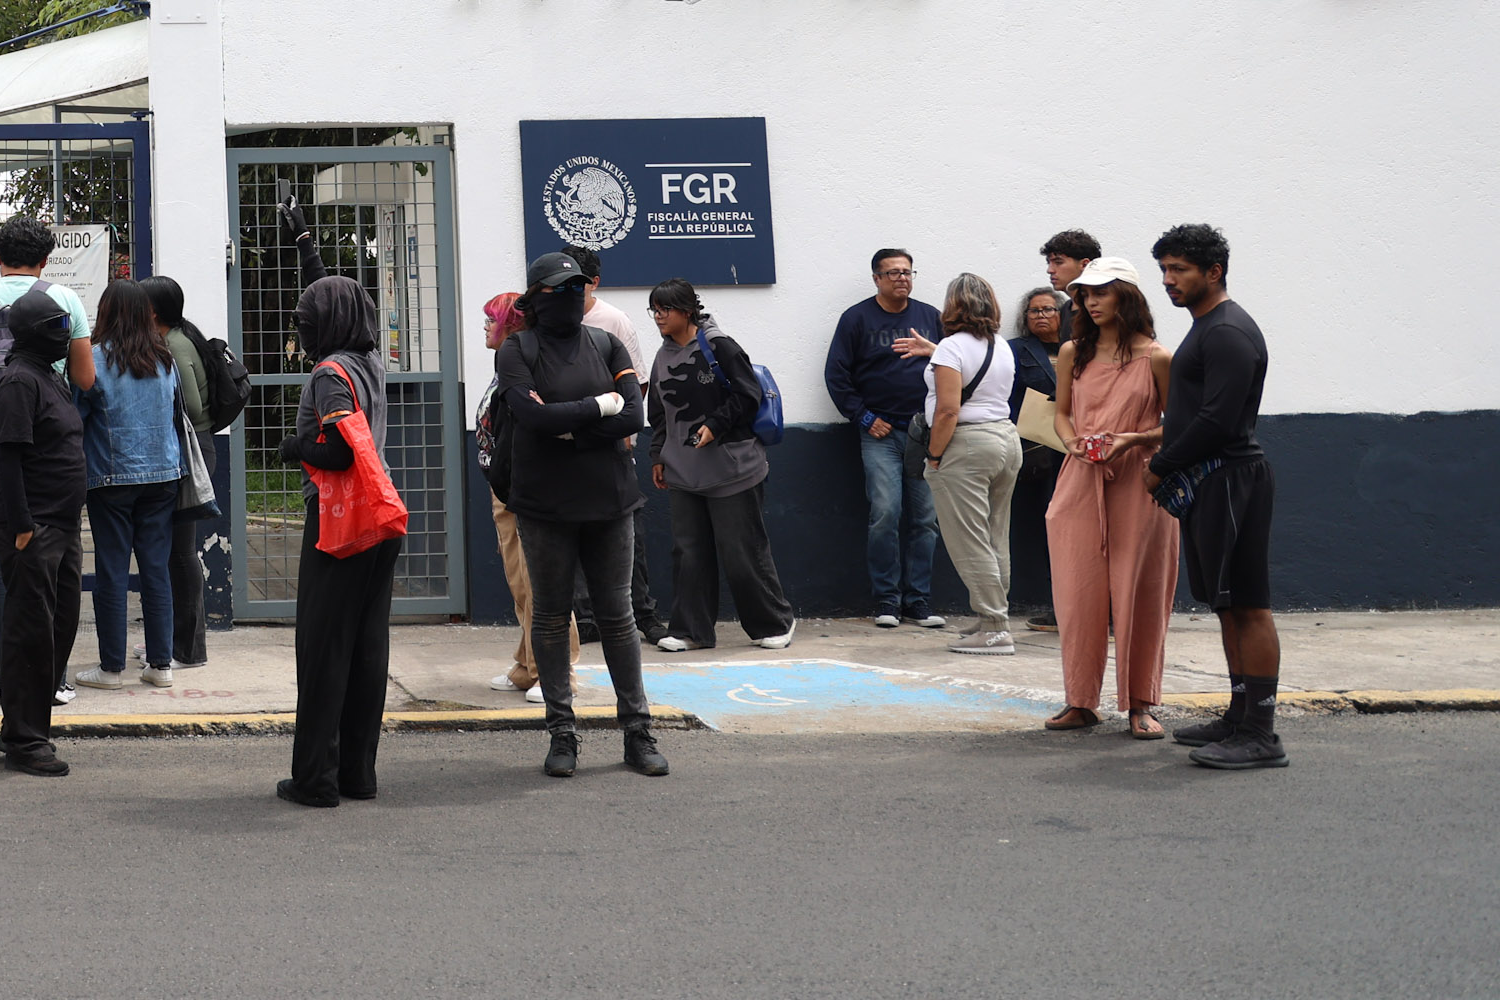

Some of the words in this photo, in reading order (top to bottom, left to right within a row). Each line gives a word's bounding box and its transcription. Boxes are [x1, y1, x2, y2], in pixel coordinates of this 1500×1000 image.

[542, 164, 566, 202] ESTADOS
[566, 156, 600, 168] UNIDOS
[601, 160, 637, 204] MEXICANOS
[661, 172, 739, 205] FGR
[647, 210, 700, 222] FISCALÍA
[701, 211, 755, 221] GENERAL
[650, 224, 666, 234] DE
[668, 223, 684, 233] LA
[686, 221, 754, 233] REPÚBLICA
[45, 256, 73, 265] ORIZADO
